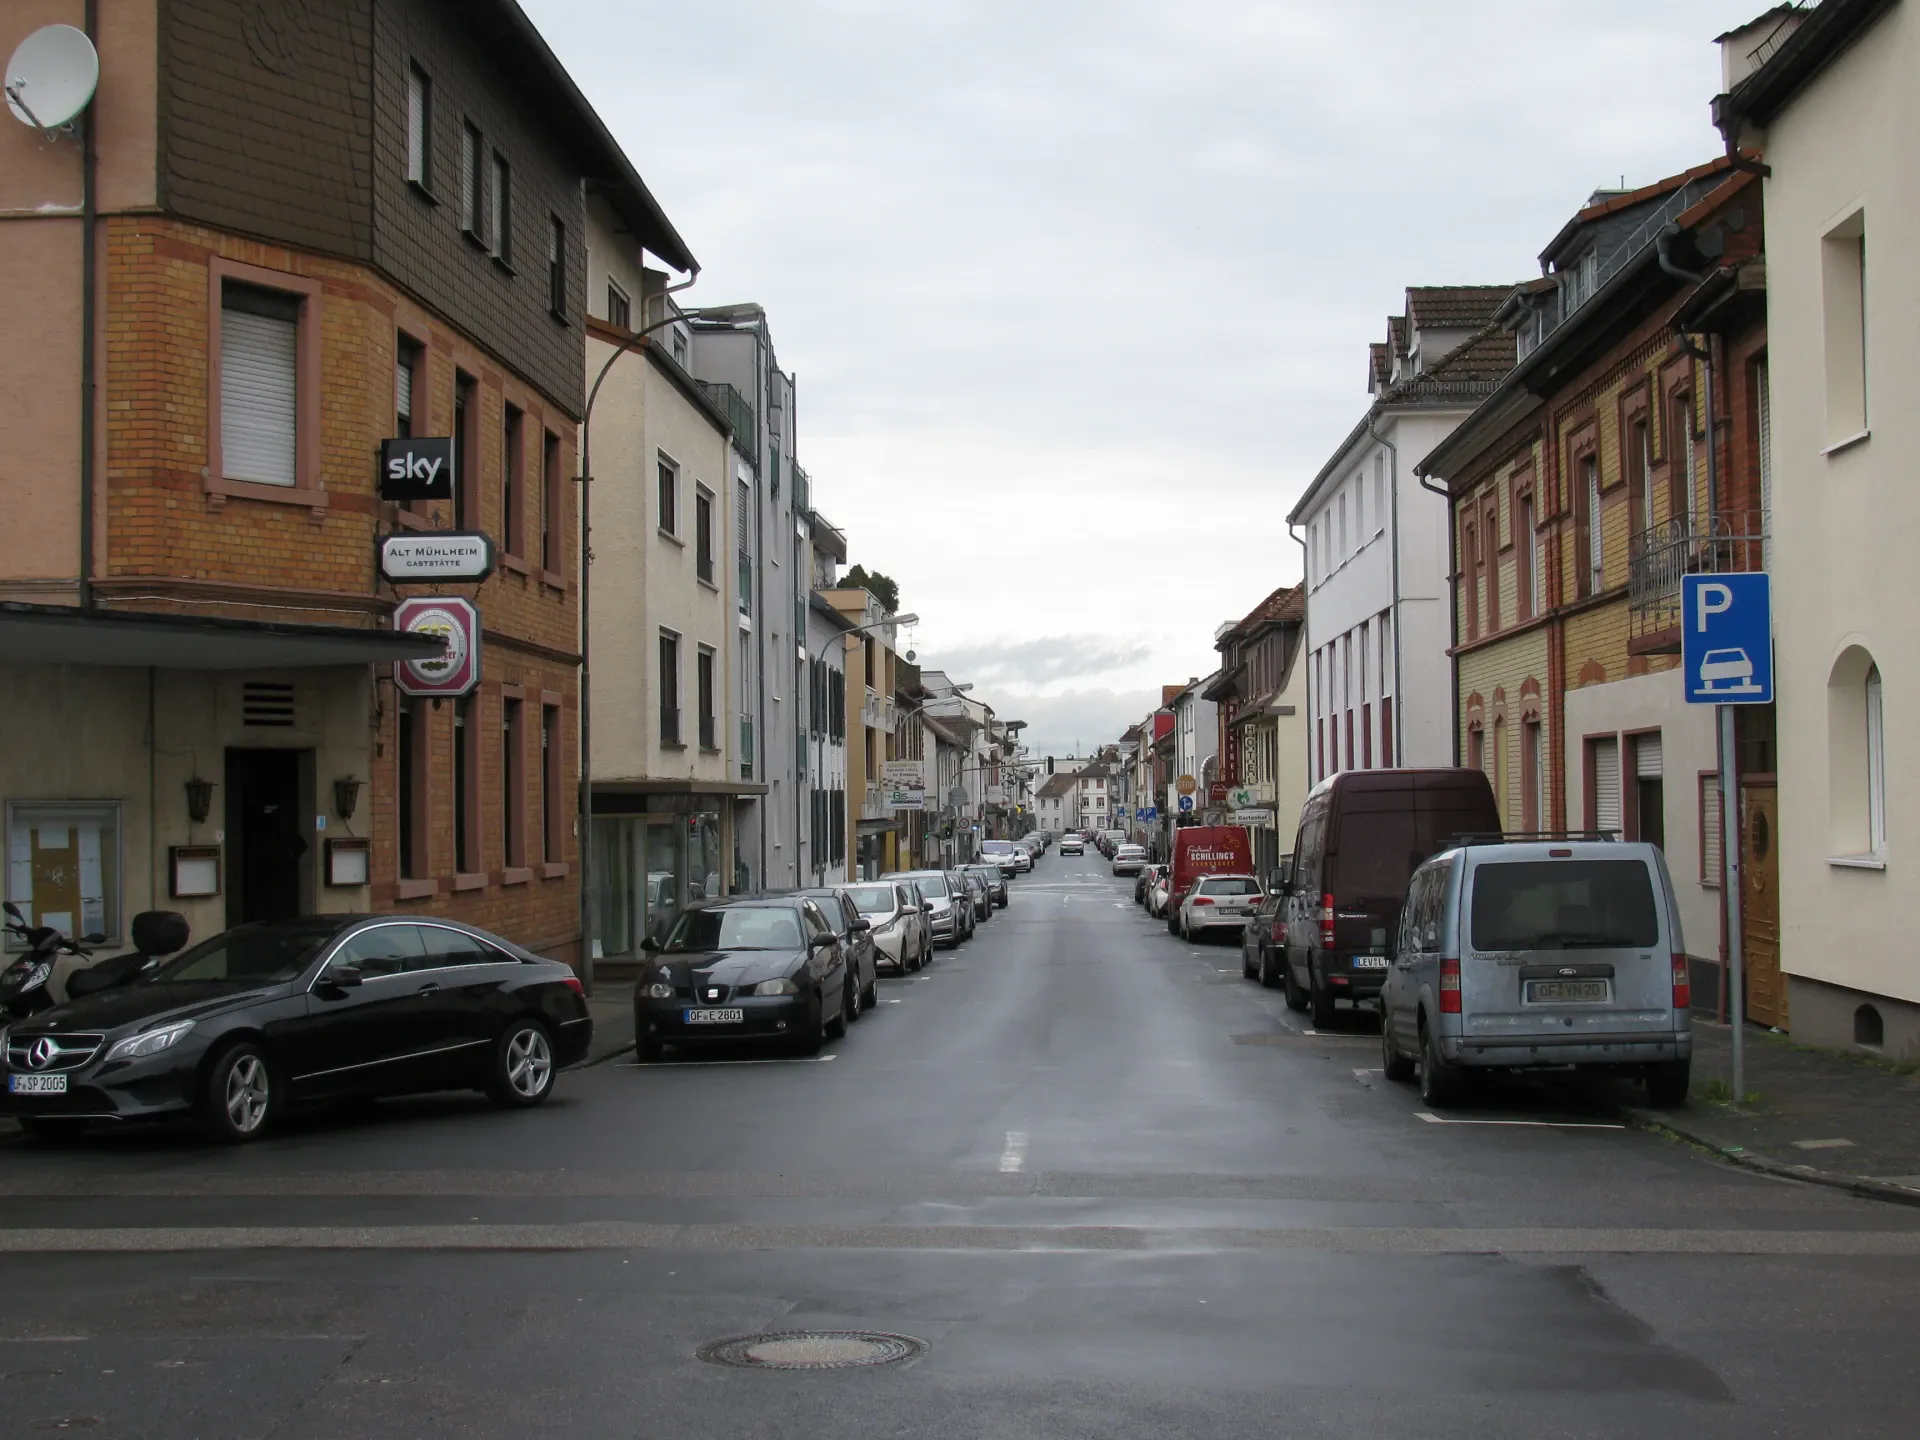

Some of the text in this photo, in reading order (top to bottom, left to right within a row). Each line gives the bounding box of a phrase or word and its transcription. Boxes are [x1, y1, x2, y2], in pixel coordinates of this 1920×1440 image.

[389, 451, 442, 485] sky
[389, 546, 478, 557] ALT MÜHLHEIM
[406, 558, 461, 567] GASTSTÄTTE
[1697, 583, 1733, 632] P
[1246, 726, 1255, 784] HOTEL
[1178, 781, 1195, 789] STOP
[690, 1011, 702, 1020] OF
[717, 1010, 741, 1020] 2801
[27, 1077, 39, 1091] SP
[40, 1076, 65, 1091] 2005
